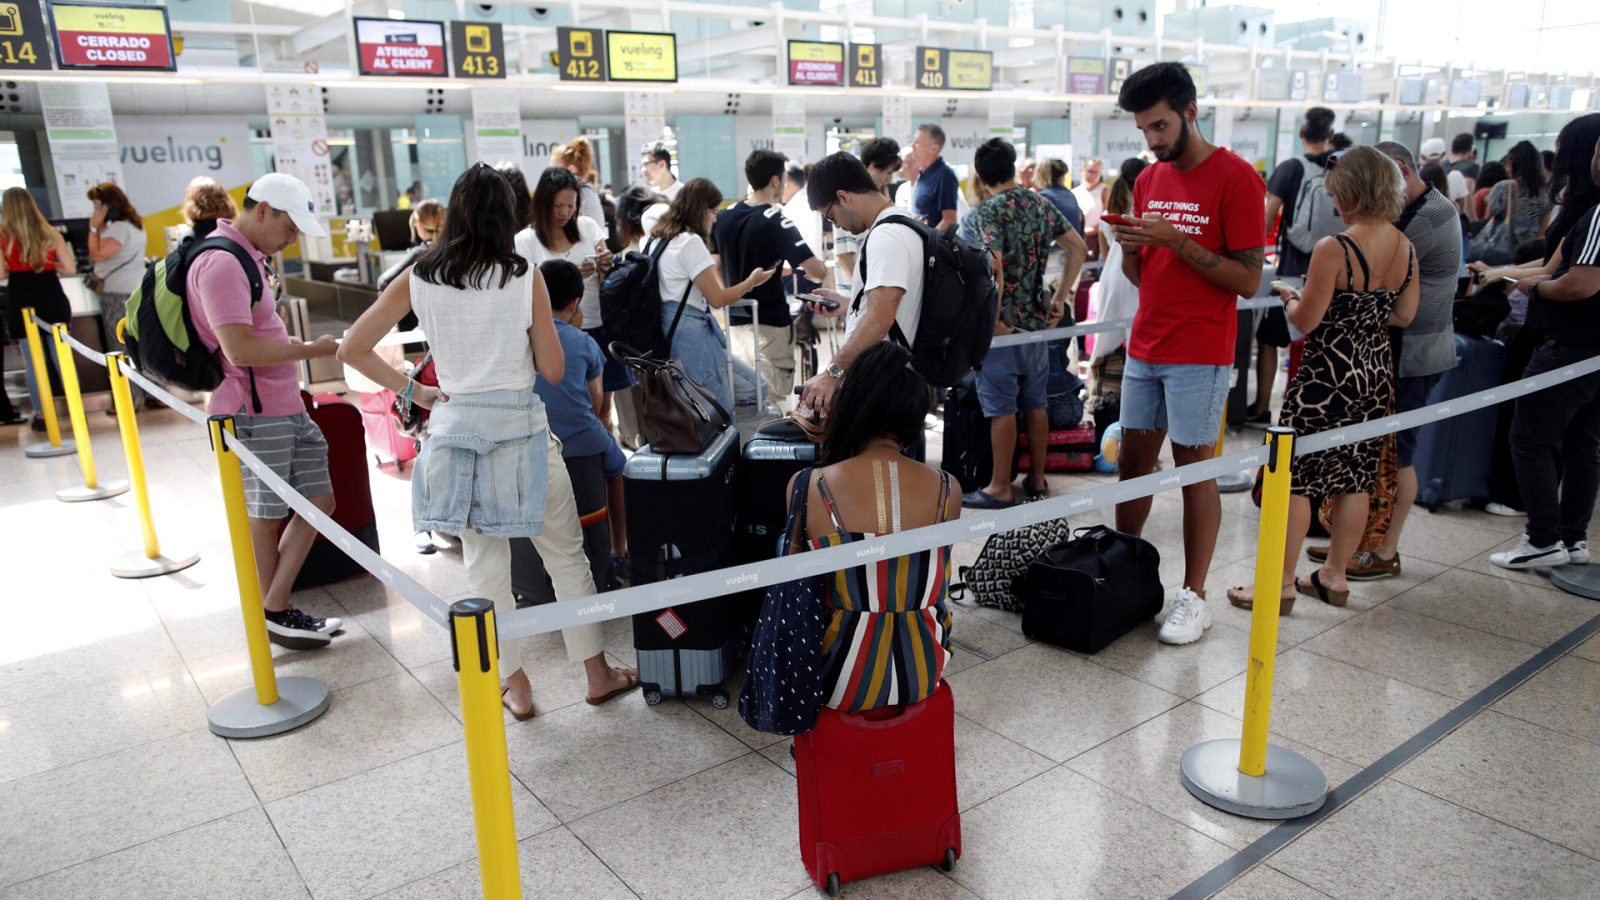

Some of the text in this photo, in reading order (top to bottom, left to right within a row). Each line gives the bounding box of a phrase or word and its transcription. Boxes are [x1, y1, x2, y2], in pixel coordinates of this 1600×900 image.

[94, 12, 126, 22] vueling
[77, 35, 151, 49] CERRADO
[0, 41, 37, 64] 14
[86, 49, 147, 61] CLOSED
[376, 45, 429, 58] ATENCIÓ
[620, 42, 665, 60] vueling
[373, 58, 434, 70] AL CLIENT
[462, 55, 499, 75] 413
[566, 59, 600, 78] 412
[956, 59, 987, 73] vueling
[855, 68, 878, 85] 411
[920, 71, 943, 88] 410
[120, 135, 223, 171] vueling
[1148, 200, 1200, 213] GREAT THINGS
[1181, 213, 1210, 225] FROM
[1172, 223, 1203, 235] ONES.
[1070, 495, 1095, 508] vueling
[969, 518, 997, 532] vueling
[856, 543, 887, 558] vueling
[725, 570, 761, 586] vueling
[577, 599, 617, 616] vueling
